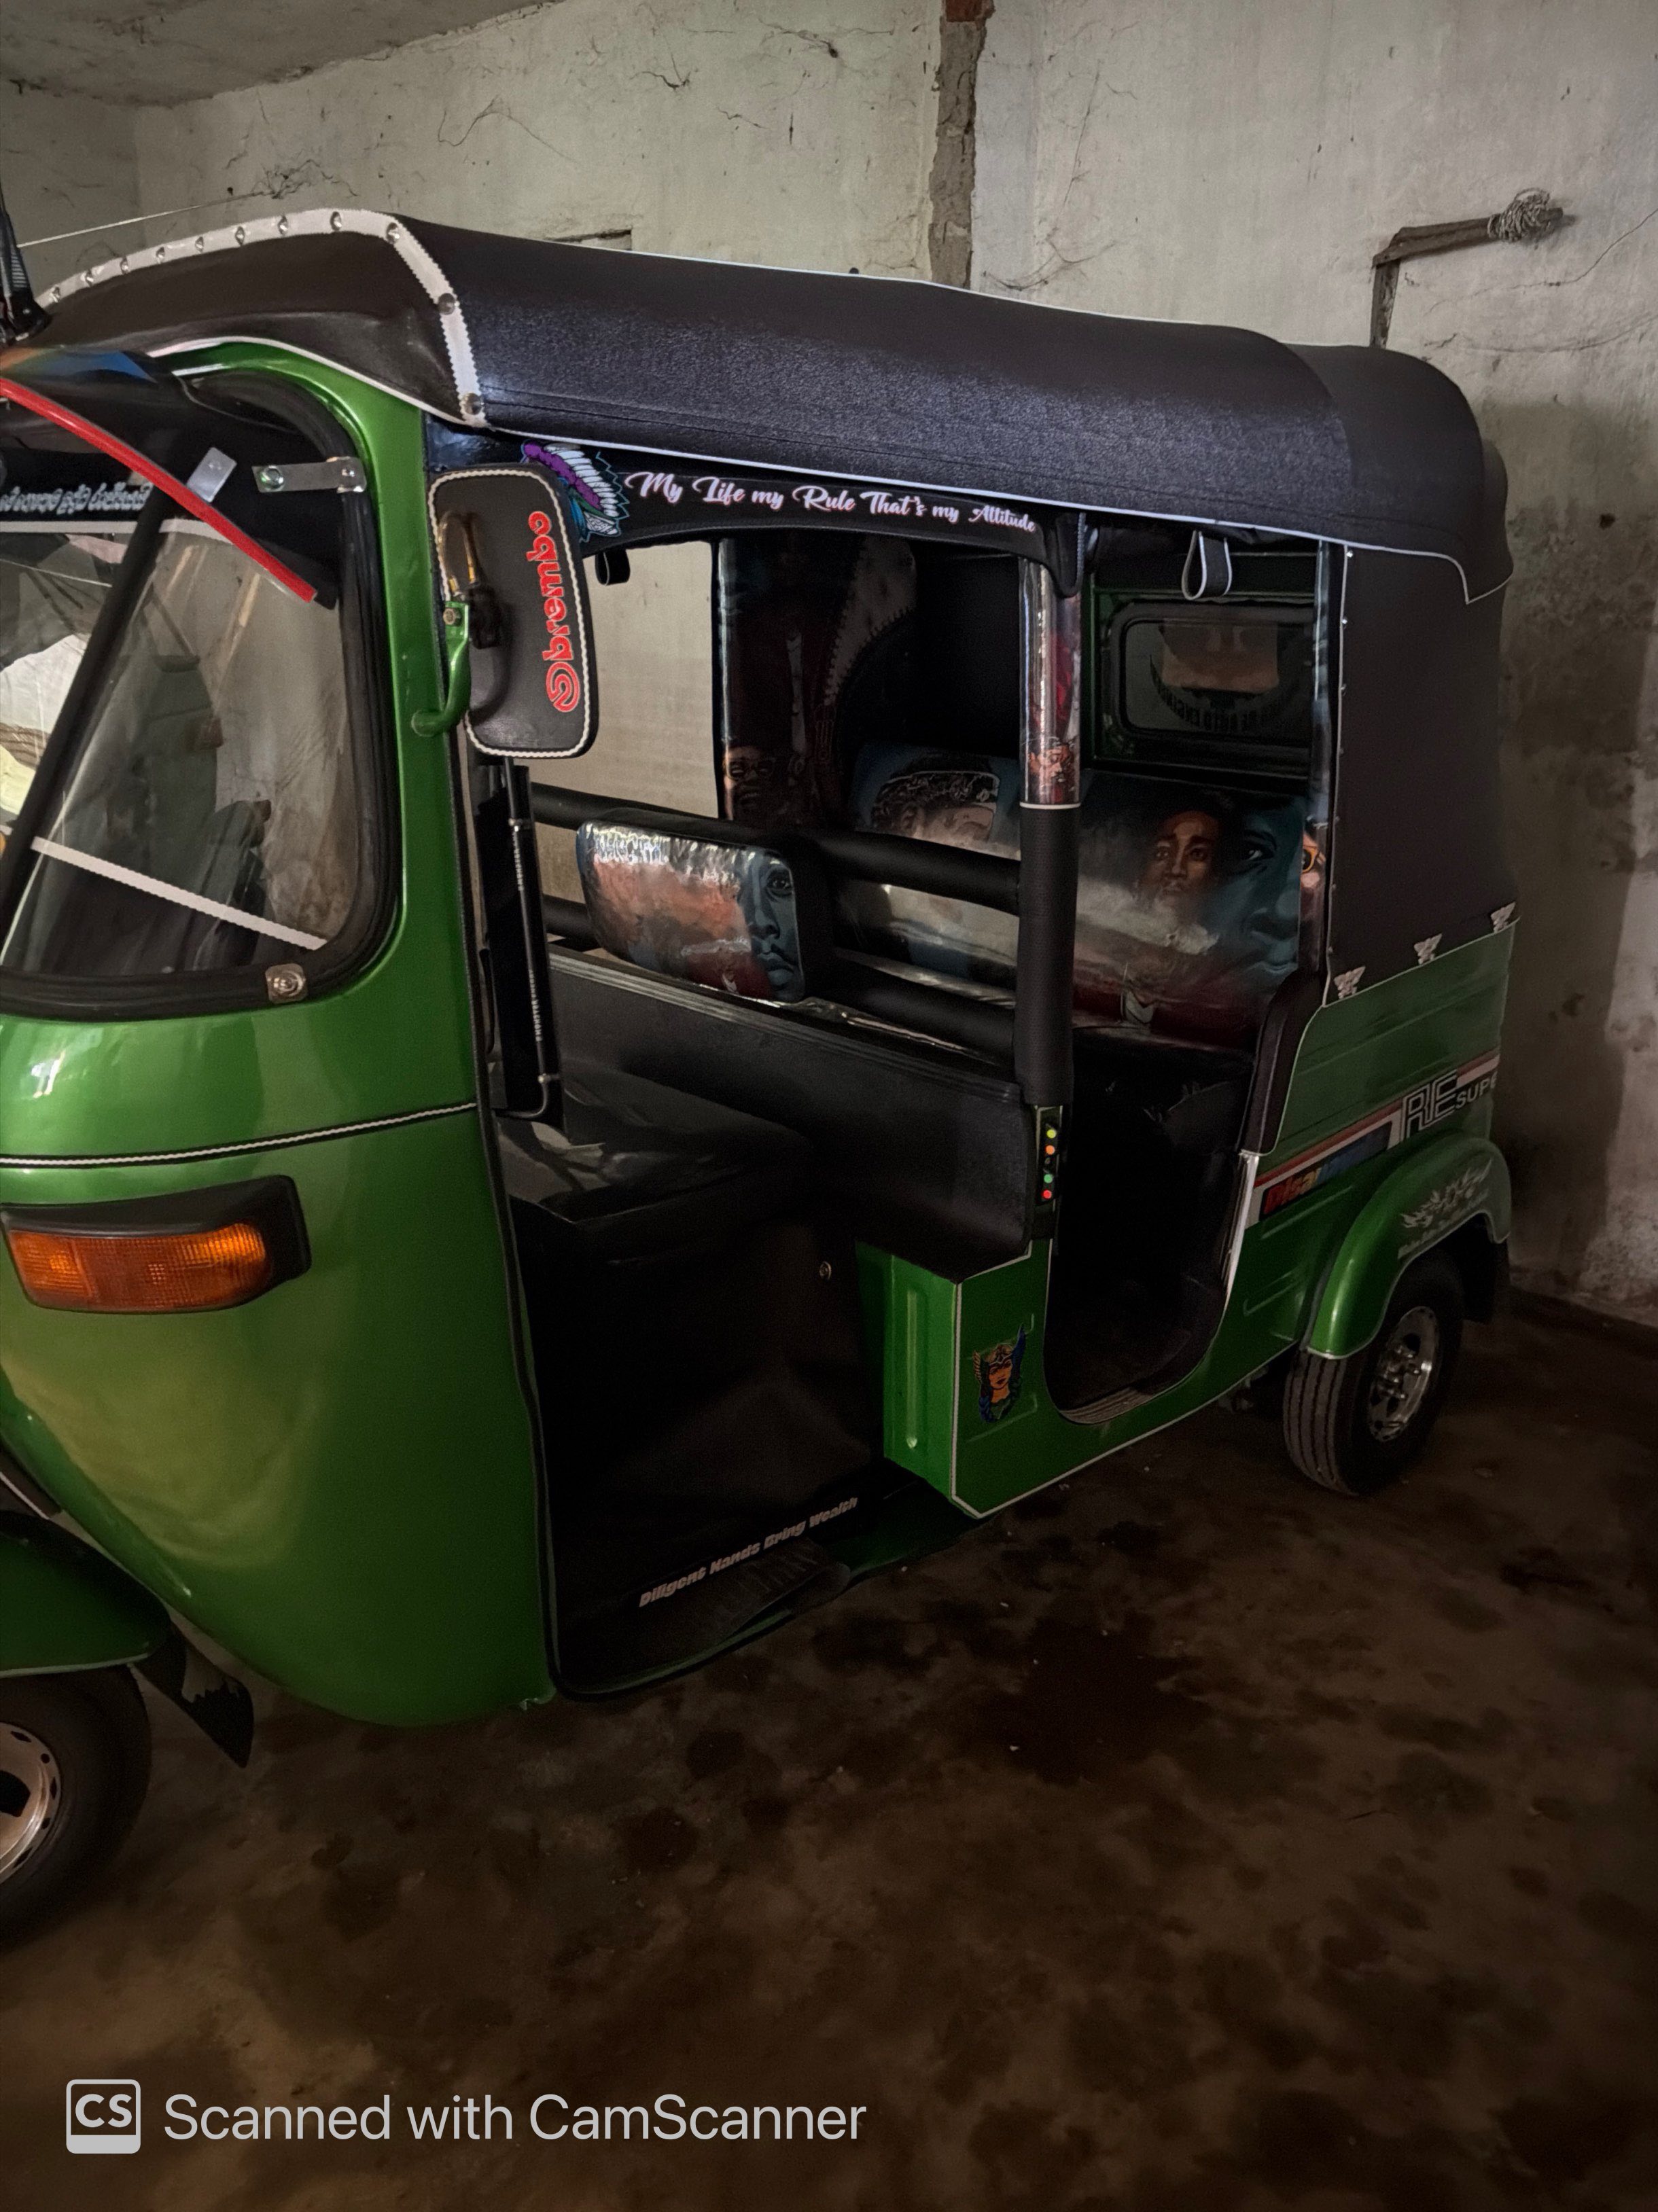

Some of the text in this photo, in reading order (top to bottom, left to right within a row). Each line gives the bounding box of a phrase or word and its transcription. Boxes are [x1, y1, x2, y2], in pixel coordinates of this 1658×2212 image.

[624, 471, 1036, 533] My Life my Rule That's my Attitude
[525, 510, 575, 662] brembo
[1400, 1068, 1458, 1143] RE
